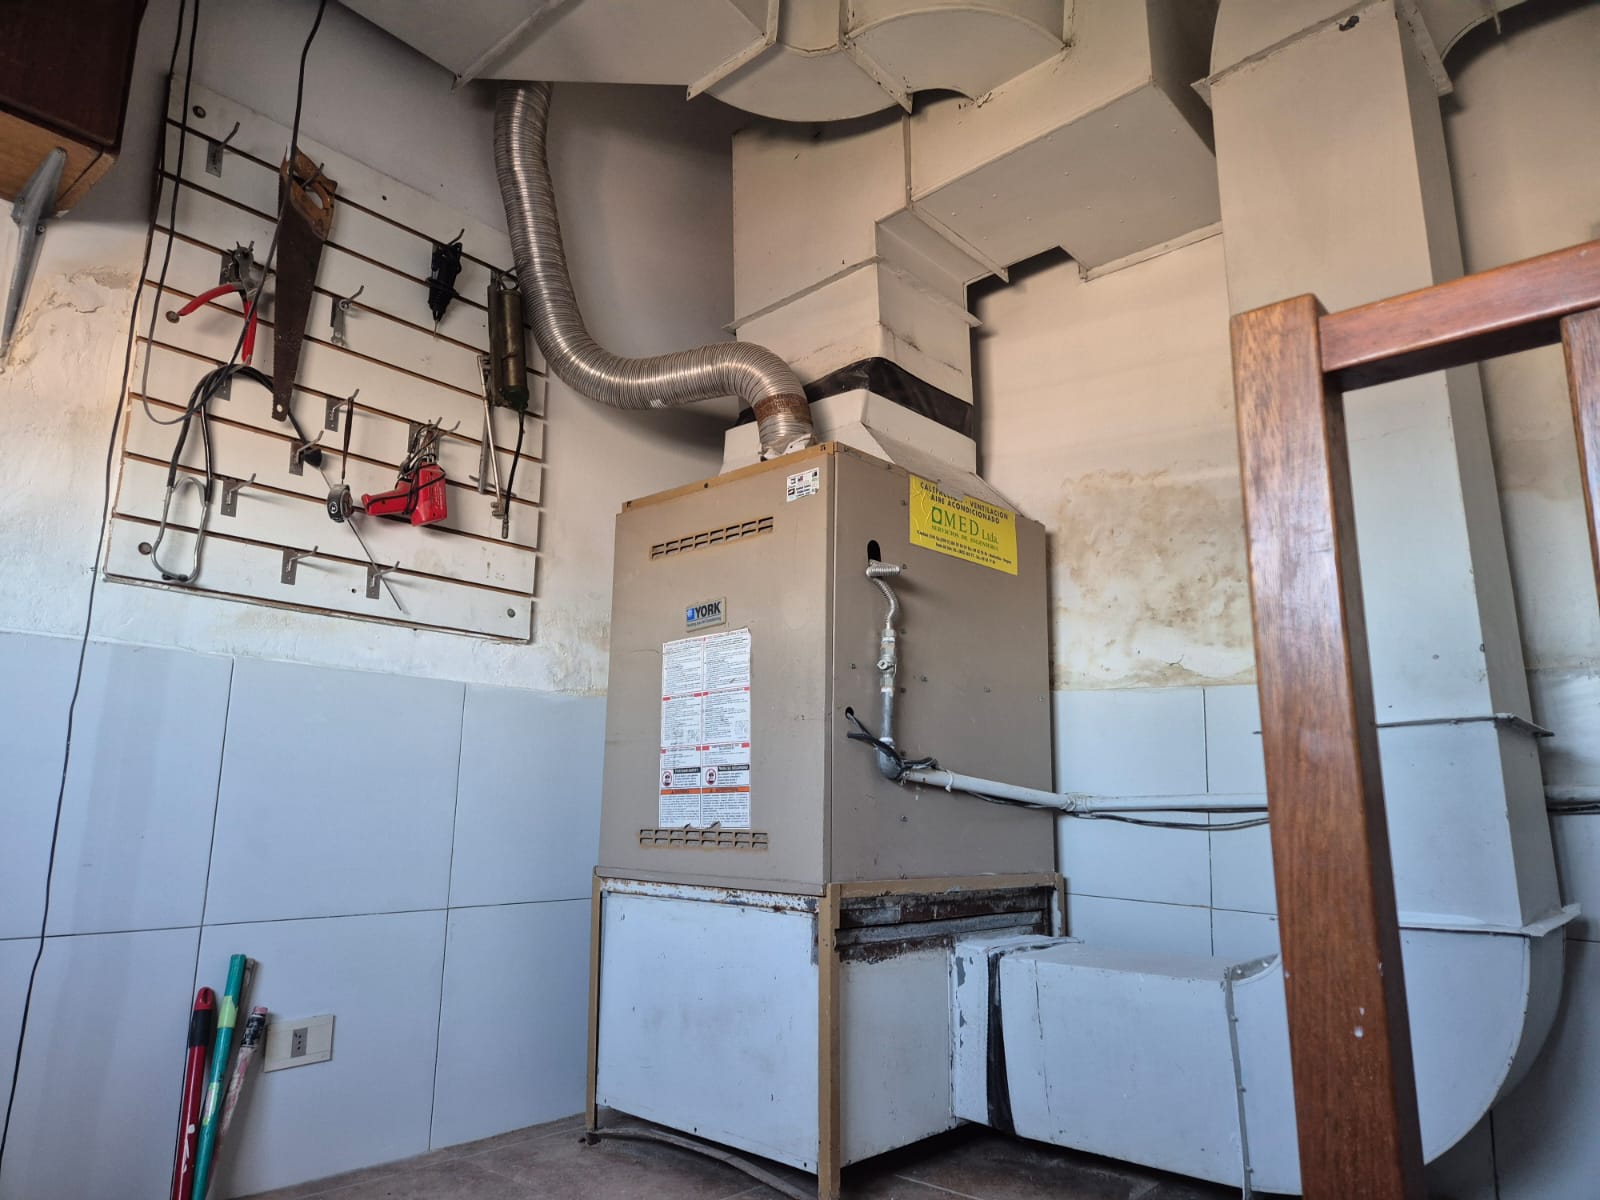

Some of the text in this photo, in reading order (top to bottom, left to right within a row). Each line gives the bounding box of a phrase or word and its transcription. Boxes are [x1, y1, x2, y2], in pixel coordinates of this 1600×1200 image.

[947, 499, 1000, 525] ACONDICIONADO
[970, 500, 1008, 520] VENTILACION
[694, 601, 721, 619] YORK
